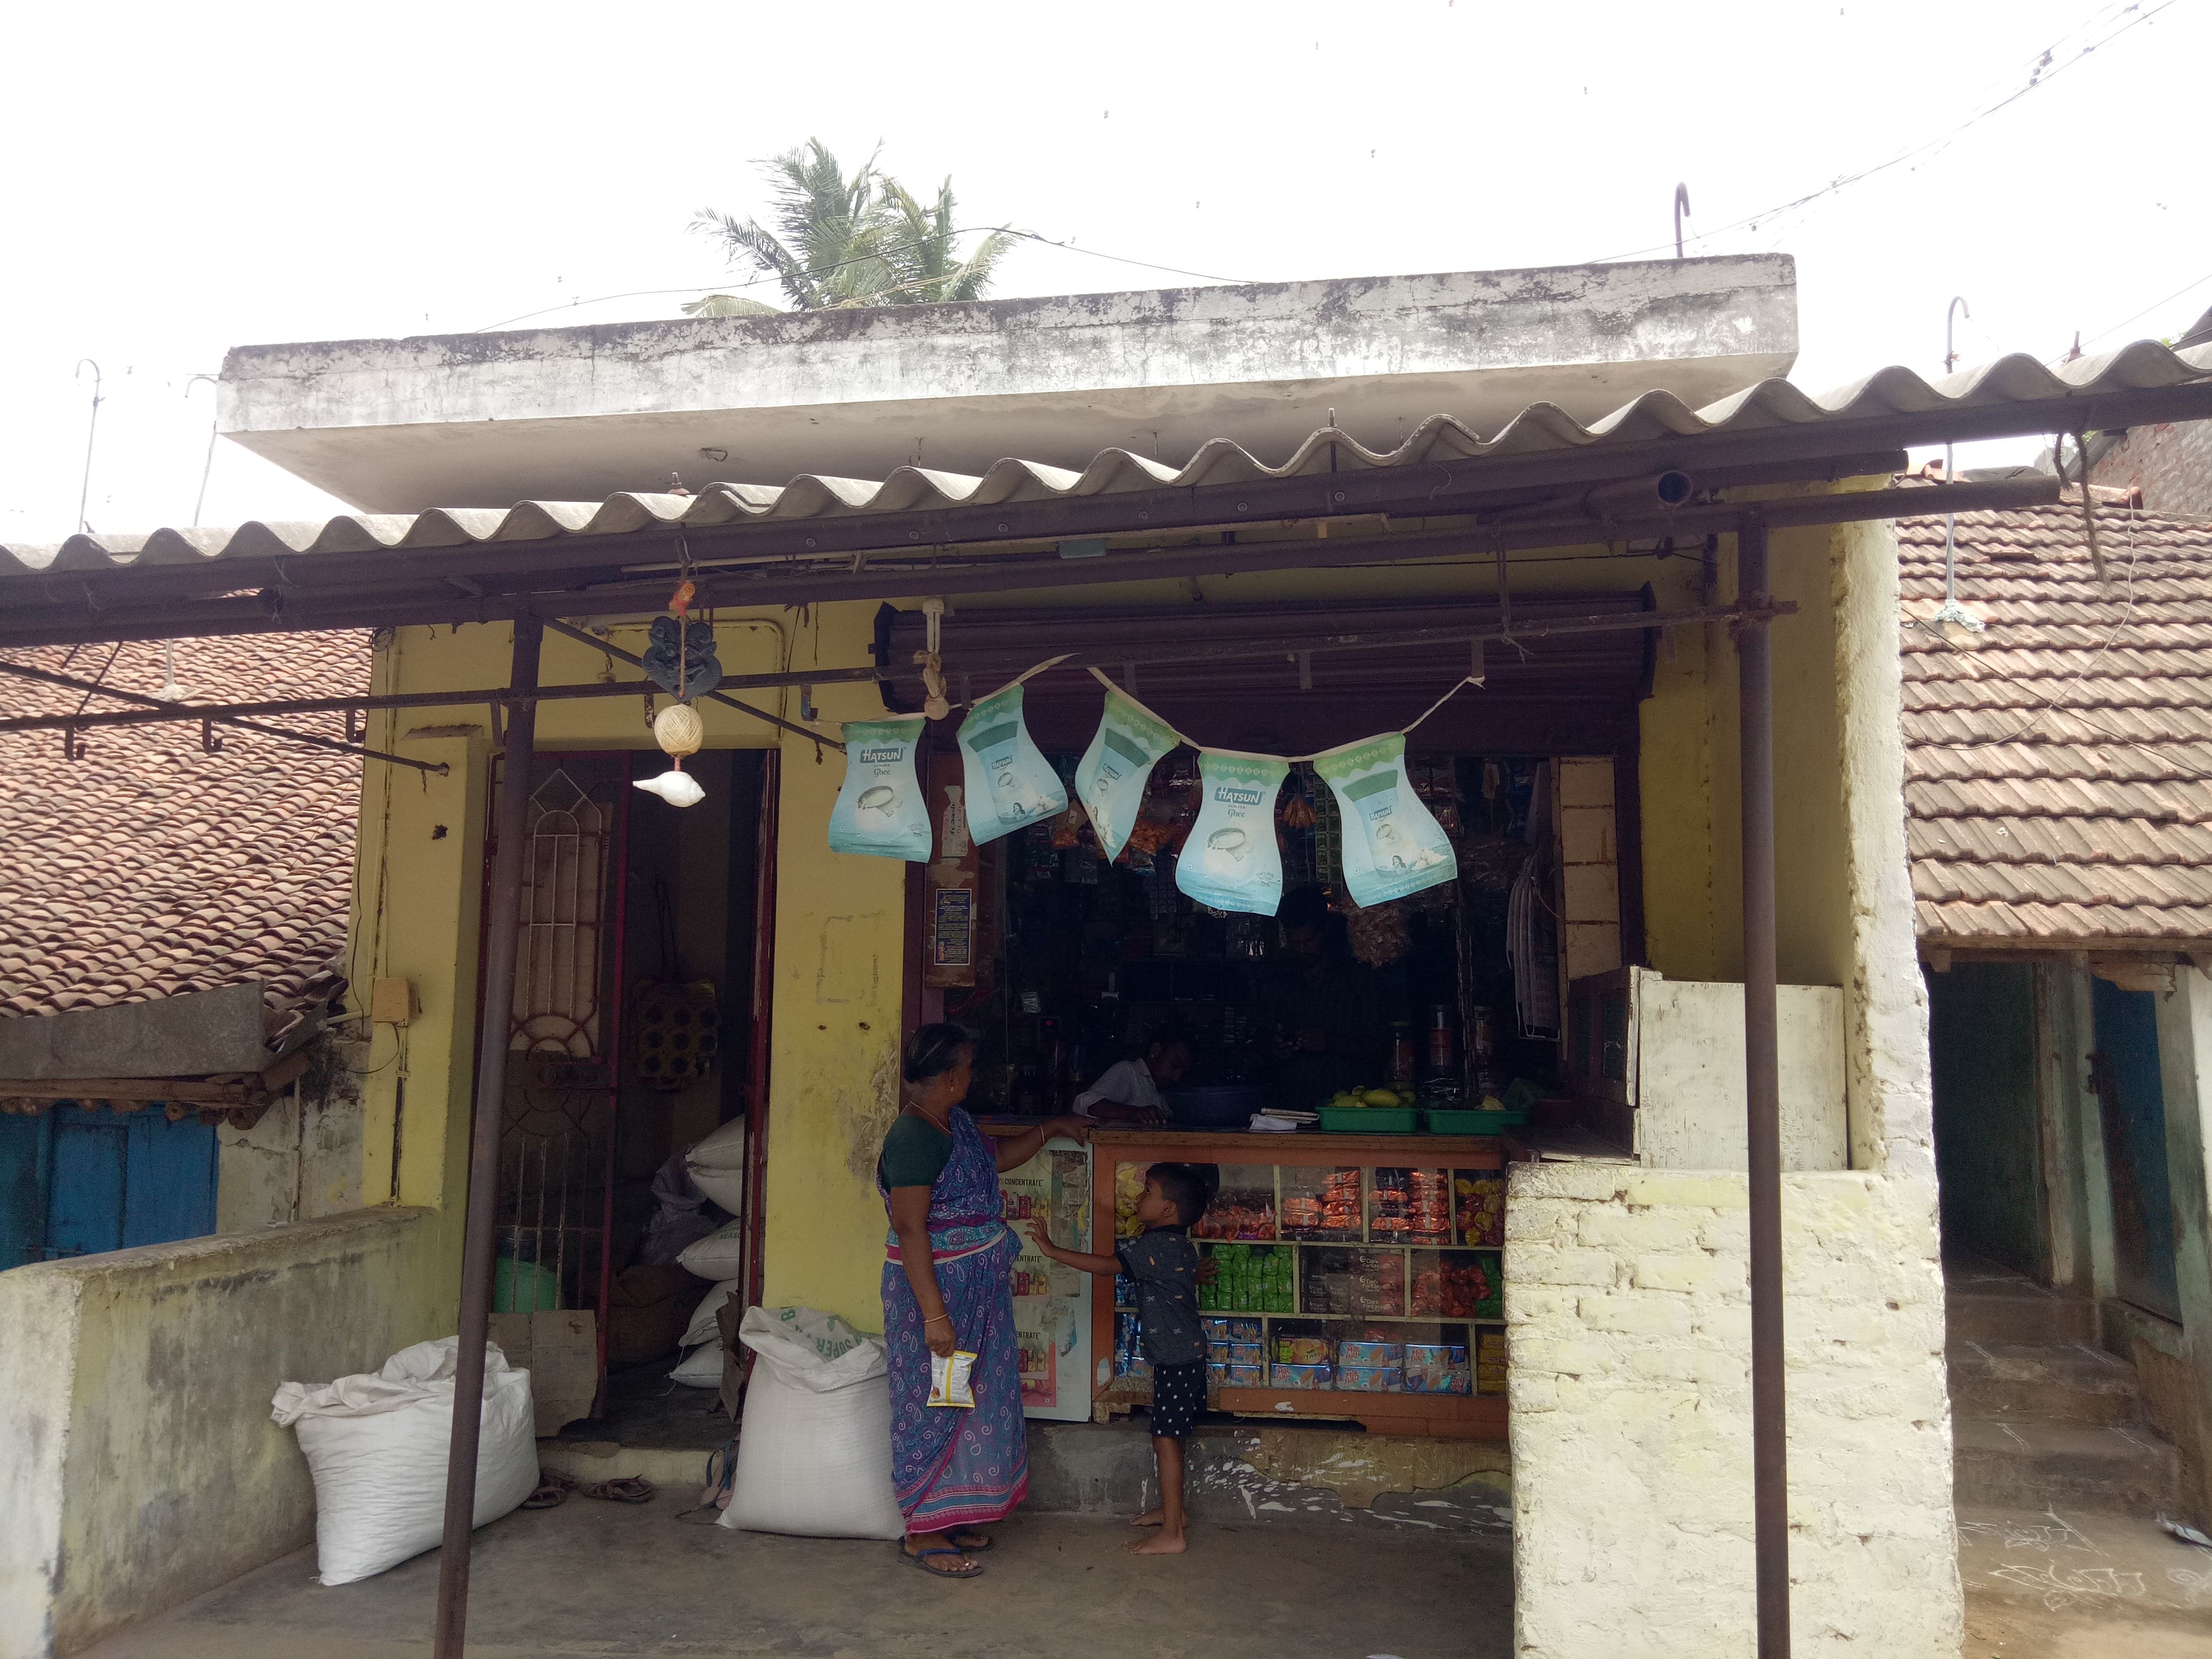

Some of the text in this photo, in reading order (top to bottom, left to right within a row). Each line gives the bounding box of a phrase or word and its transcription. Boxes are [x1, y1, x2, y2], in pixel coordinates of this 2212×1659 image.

[862, 748, 901, 763] HATSUN
[991, 755, 1012, 769] HATSUN
[874, 768, 891, 777] Ghee
[1218, 787, 1260, 803] HATSUN
[1228, 809, 1246, 818] Ghee
[1370, 806, 1391, 820] HATSUN
[1016, 1331, 1039, 1339] ENTRATE
